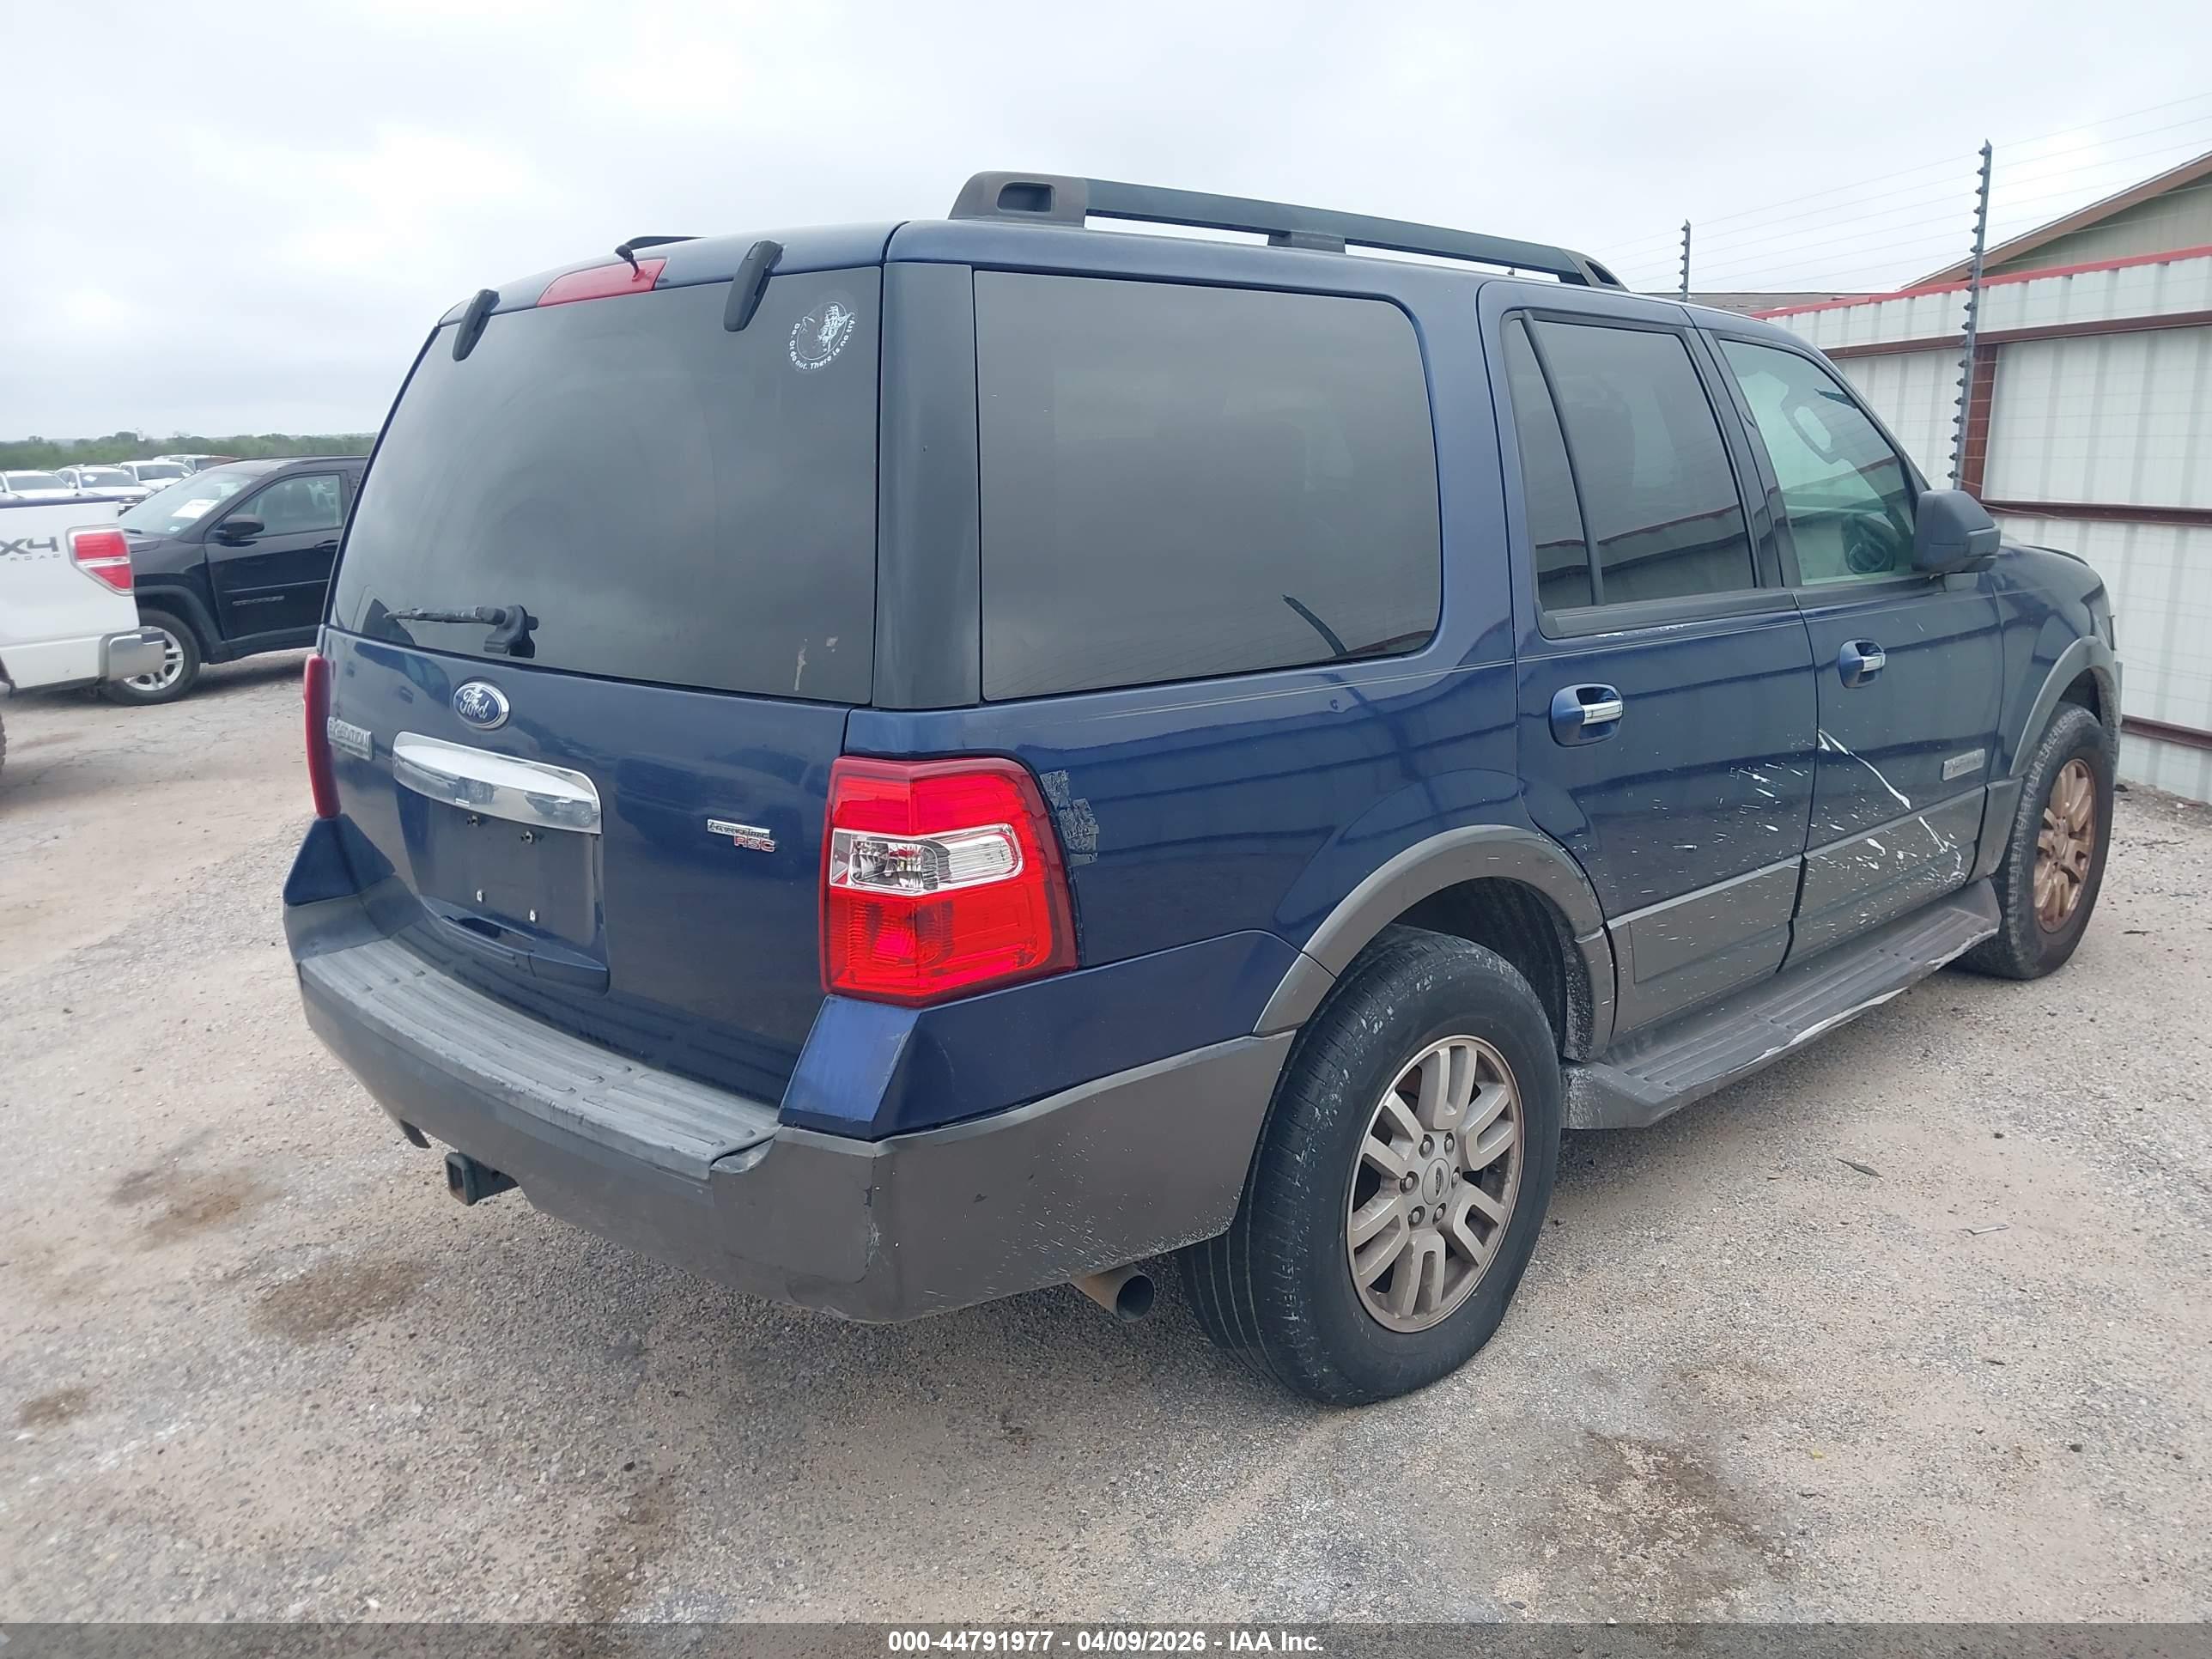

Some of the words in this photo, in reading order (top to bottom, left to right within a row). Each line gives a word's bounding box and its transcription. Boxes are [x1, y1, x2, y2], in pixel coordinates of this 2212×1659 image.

[810, 354, 832, 369] There
[840, 335, 849, 347] no
[459, 689, 489, 719] Ford
[734, 834, 776, 853] RSC
